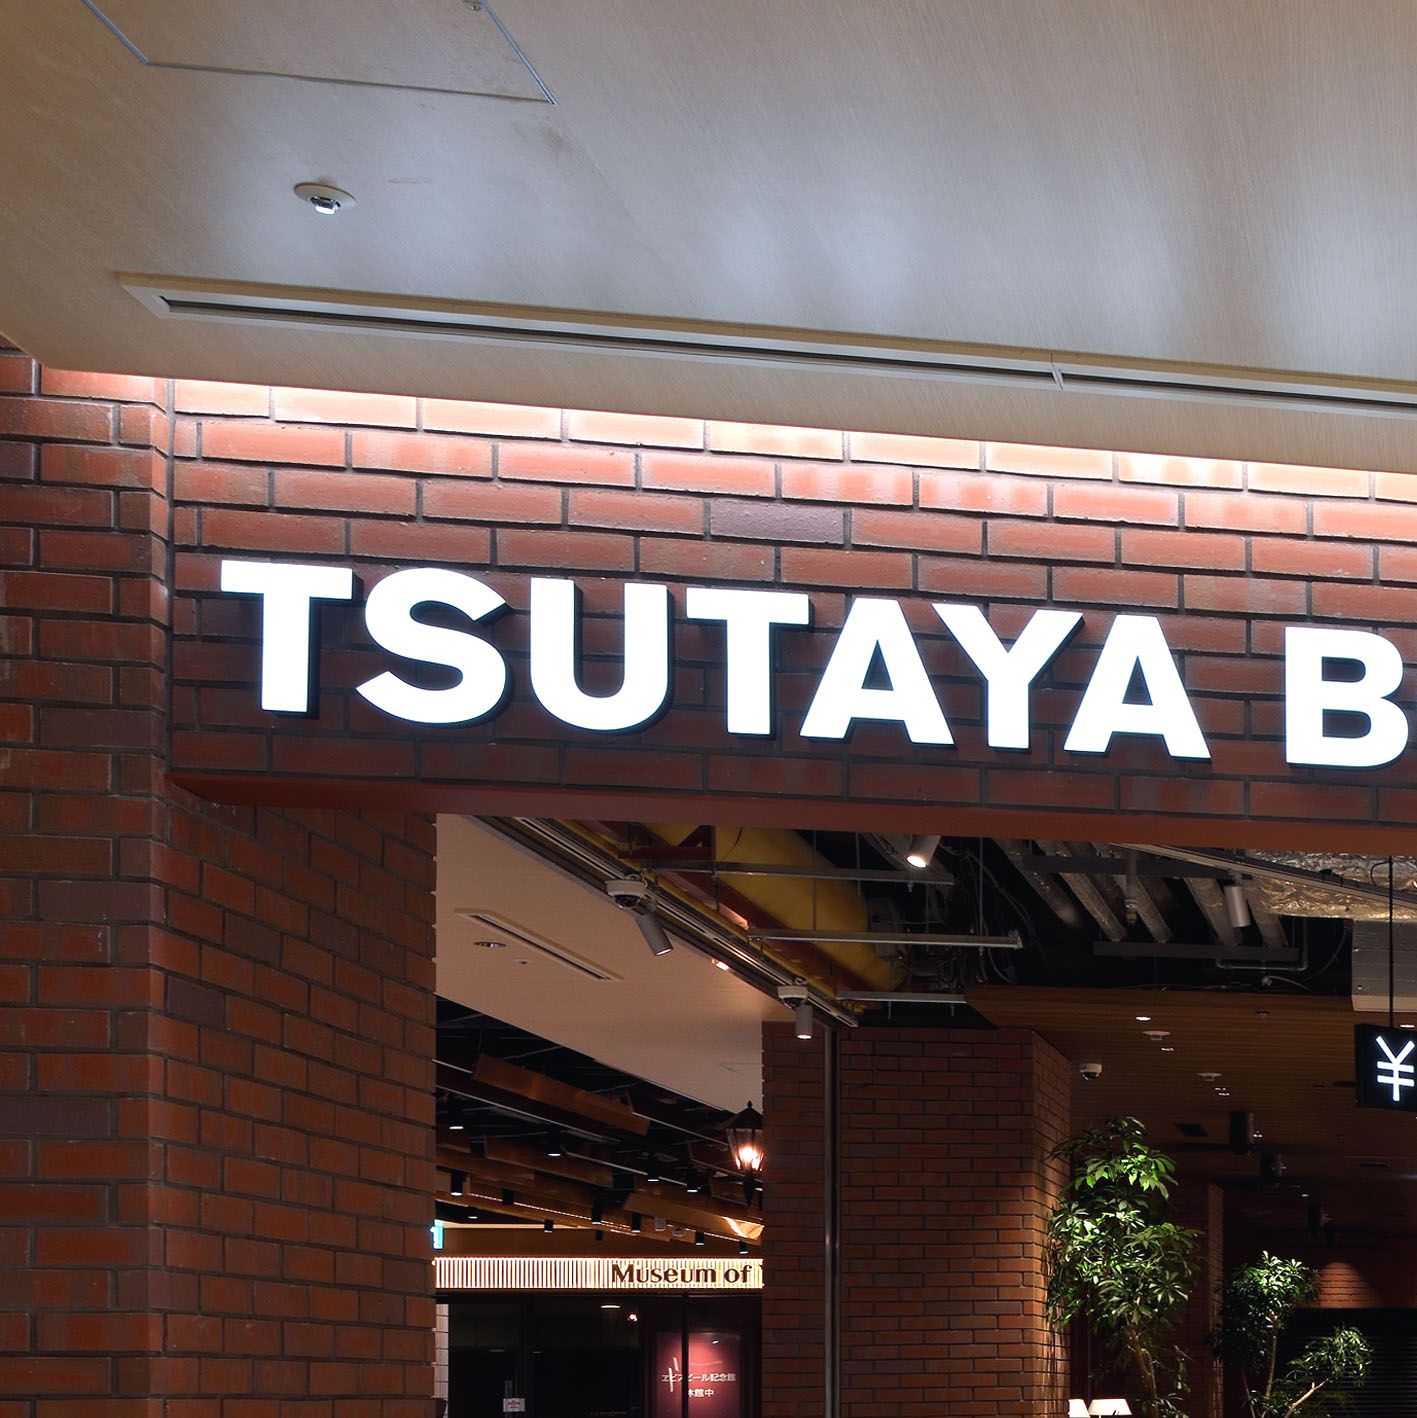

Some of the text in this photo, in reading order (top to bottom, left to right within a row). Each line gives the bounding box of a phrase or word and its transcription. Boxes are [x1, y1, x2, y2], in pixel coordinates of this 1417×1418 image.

[221, 560, 1210, 757] TSUTAYA
[611, 1264, 753, 1284] Museum of
